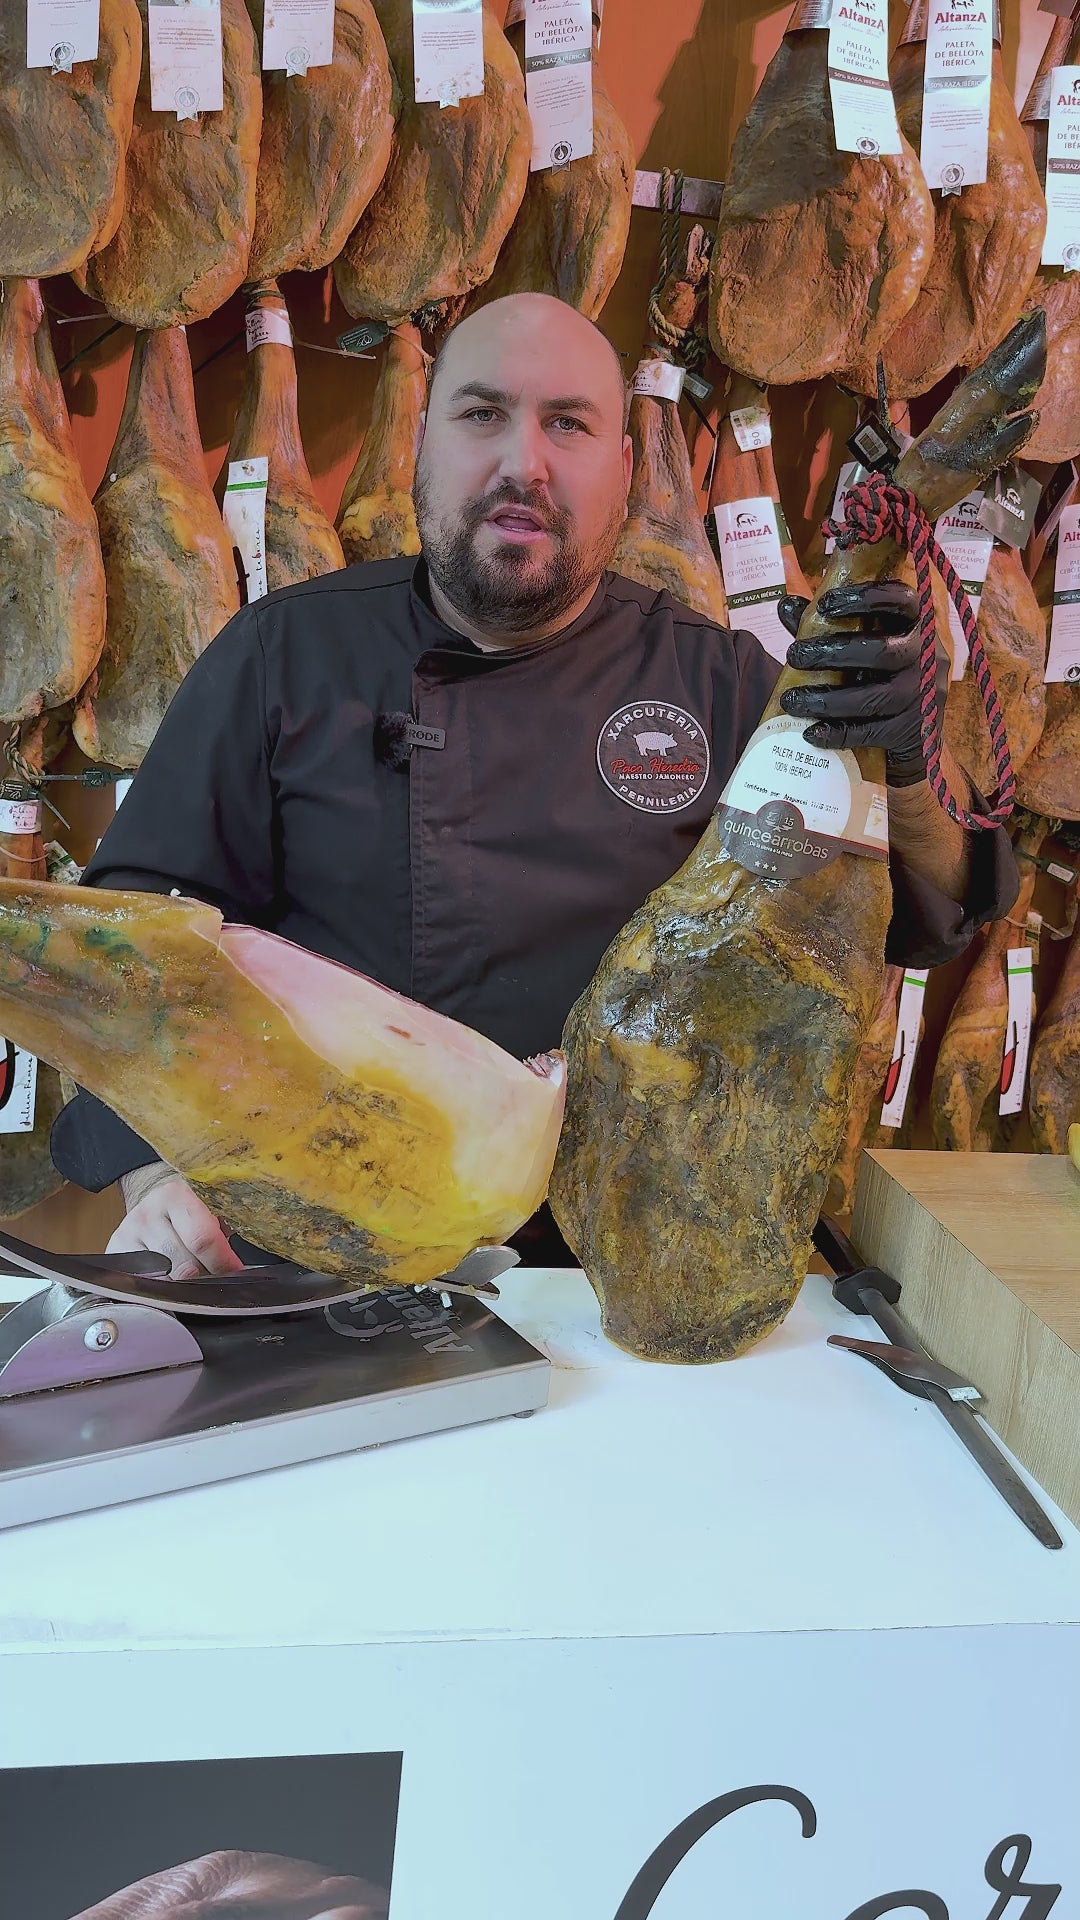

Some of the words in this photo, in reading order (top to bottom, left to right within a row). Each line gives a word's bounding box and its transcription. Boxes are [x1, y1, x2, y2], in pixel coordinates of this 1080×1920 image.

[545, 18, 573, 28] PALETA
[548, 26, 584, 37] BELLOTA
[543, 36, 575, 45] IBÉRICA
[846, 41, 872, 54] PALETA
[844, 57, 873, 70] IBÉRICA
[849, 51, 880, 65] BELLOTA
[943, 58, 975, 66] IBÉRICA
[736, 558, 759, 568] PALETA
[960, 556, 985, 564] CAMPO
[755, 561, 780, 572] CAMPO
[607, 707, 698, 741] XARCUTERIA
[772, 745, 793, 759] PALETA
[795, 752, 805, 762] DE
[804, 754, 830, 770] BELLOTA
[611, 759, 643, 774] Paco
[650, 757, 699, 773] Heredia
[619, 785, 697, 807] PERNILERIA
[784, 817, 794, 826] 15
[724, 819, 829, 859] quincearrobas
